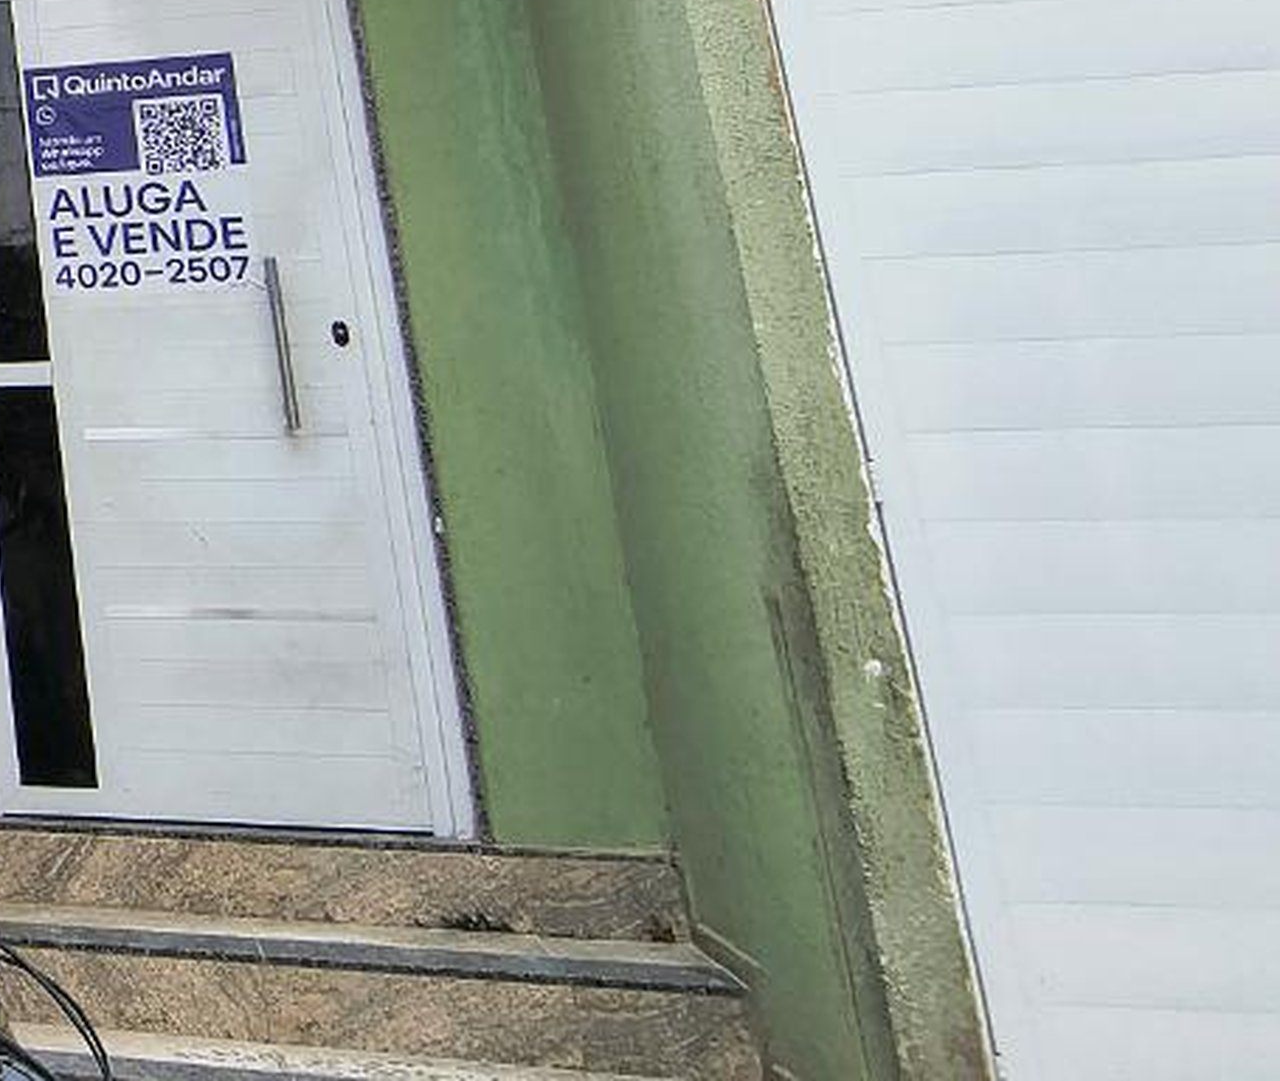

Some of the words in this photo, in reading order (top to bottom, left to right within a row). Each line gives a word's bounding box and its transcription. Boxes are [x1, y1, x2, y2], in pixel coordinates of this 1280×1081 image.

[63, 66, 226, 95] QuintoAndar
[49, 180, 207, 220] ALUGA
[54, 226, 78, 258] E
[87, 216, 248, 256] VENDE
[55, 256, 249, 289] 4020-2507
